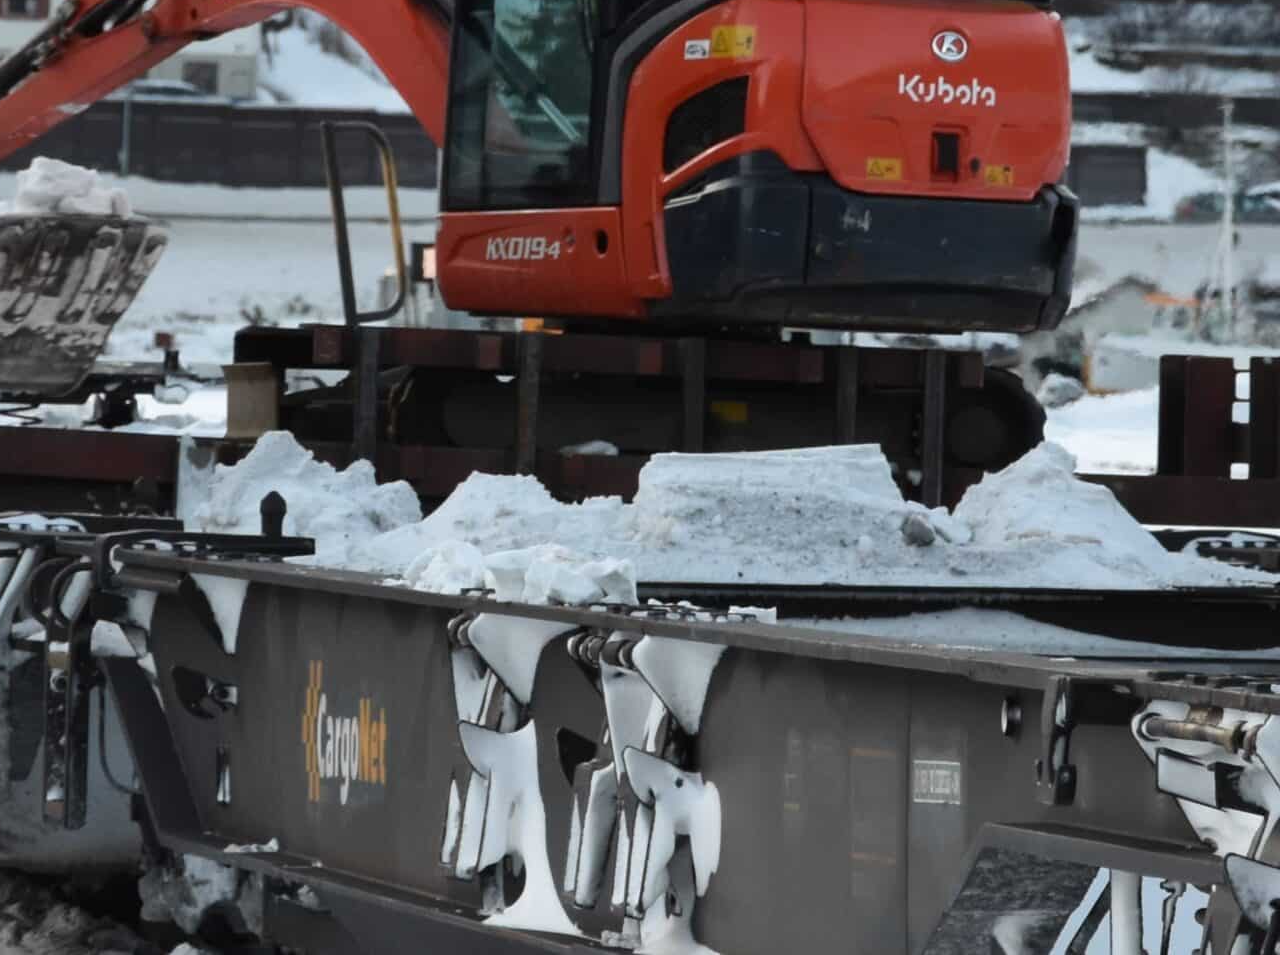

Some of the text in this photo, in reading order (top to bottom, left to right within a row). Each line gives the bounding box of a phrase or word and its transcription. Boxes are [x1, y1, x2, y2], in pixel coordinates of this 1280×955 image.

[899, 73, 996, 106] Kubota
[486, 236, 561, 261] KX019-4
[317, 693, 388, 805] CargoNet
